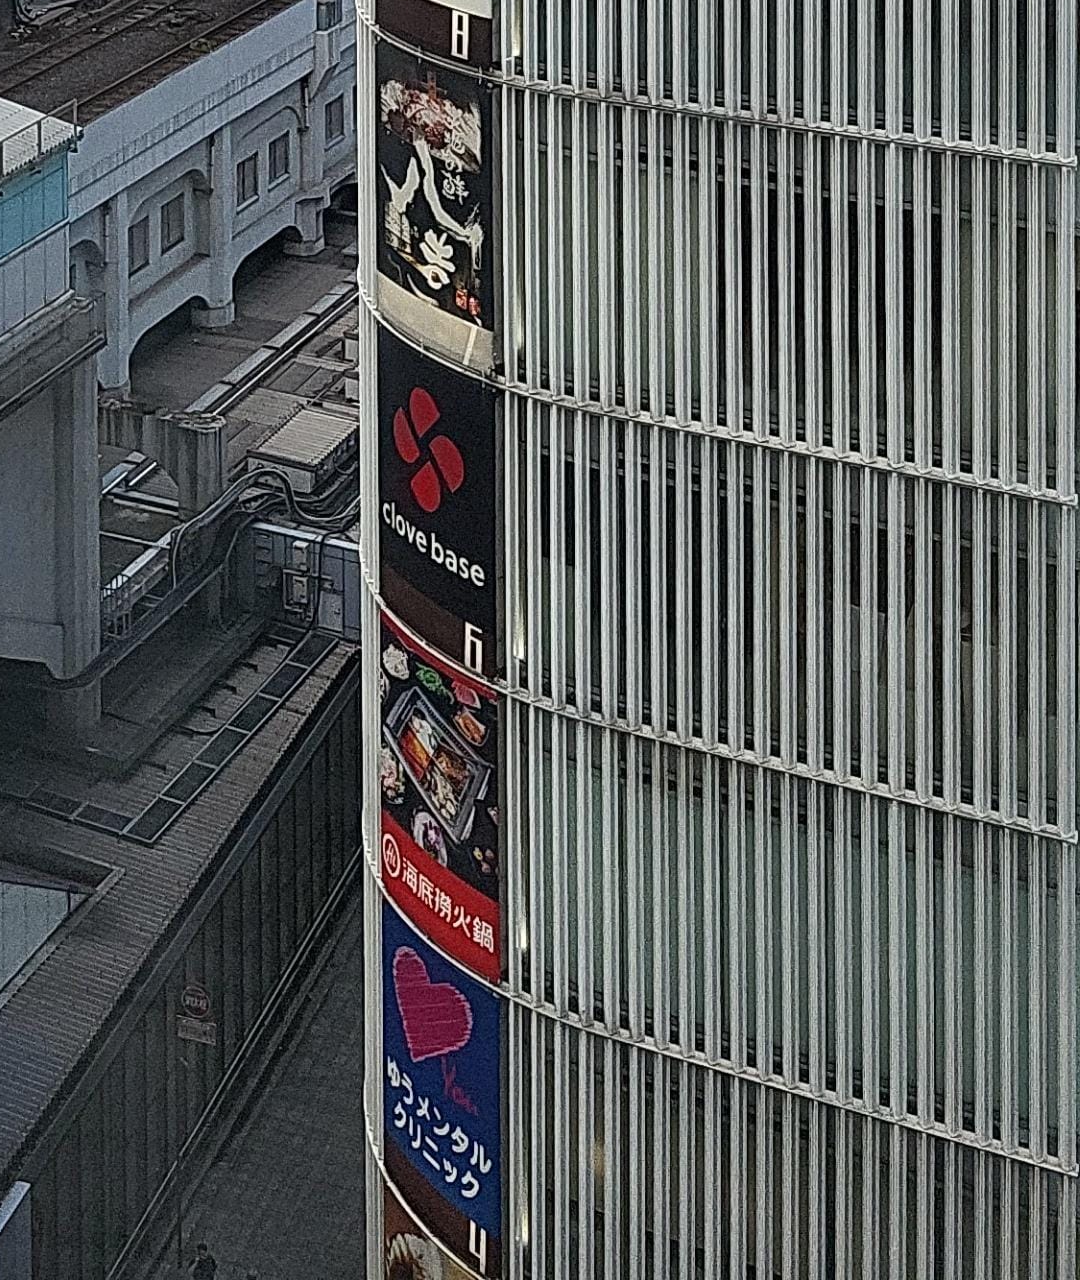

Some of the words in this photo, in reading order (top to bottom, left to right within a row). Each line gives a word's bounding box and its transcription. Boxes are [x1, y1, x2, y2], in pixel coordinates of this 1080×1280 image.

[382, 501, 428, 554] clove
[431, 532, 485, 588] base
[464, 621, 482, 676] 6
[387, 1056, 492, 1174] ゆうメンタル
[394, 1101, 480, 1198] クリニック
[469, 1219, 487, 1276] 4
